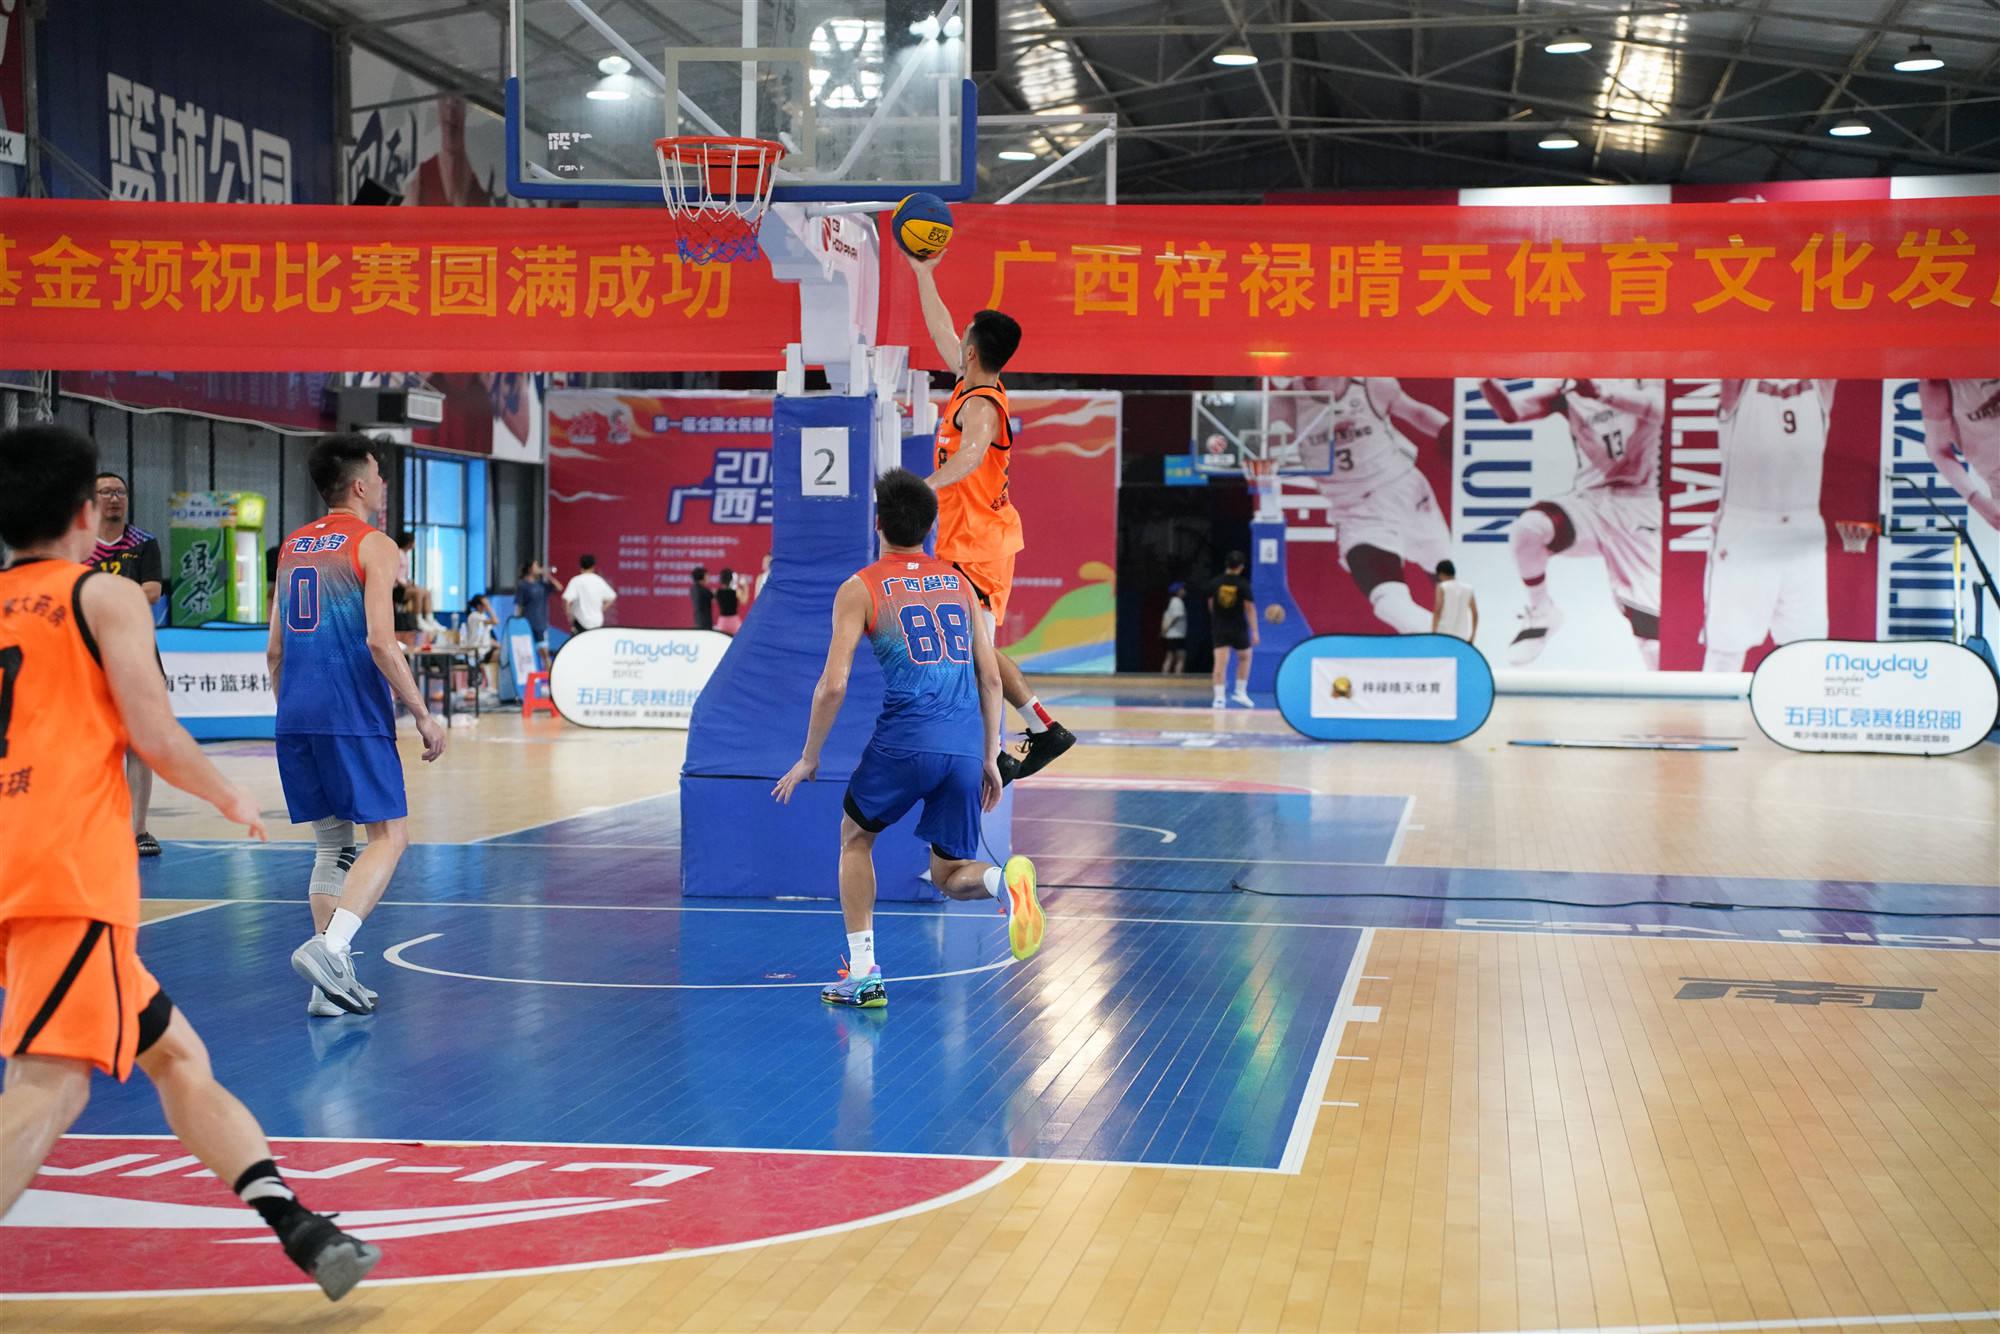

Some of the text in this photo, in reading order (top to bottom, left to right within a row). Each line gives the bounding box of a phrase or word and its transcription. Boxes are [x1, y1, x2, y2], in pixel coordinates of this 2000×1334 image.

[985, 228, 2000, 318] 广西梓禄晴天体育文化发
[1783, 410, 1797, 434] 9
[714, 451, 773, 484] 20
[814, 448, 836, 485] 2
[287, 566, 320, 632] 0
[898, 602, 971, 664] 88
[1785, 706, 1961, 730] 五月汇竞赛组织部
